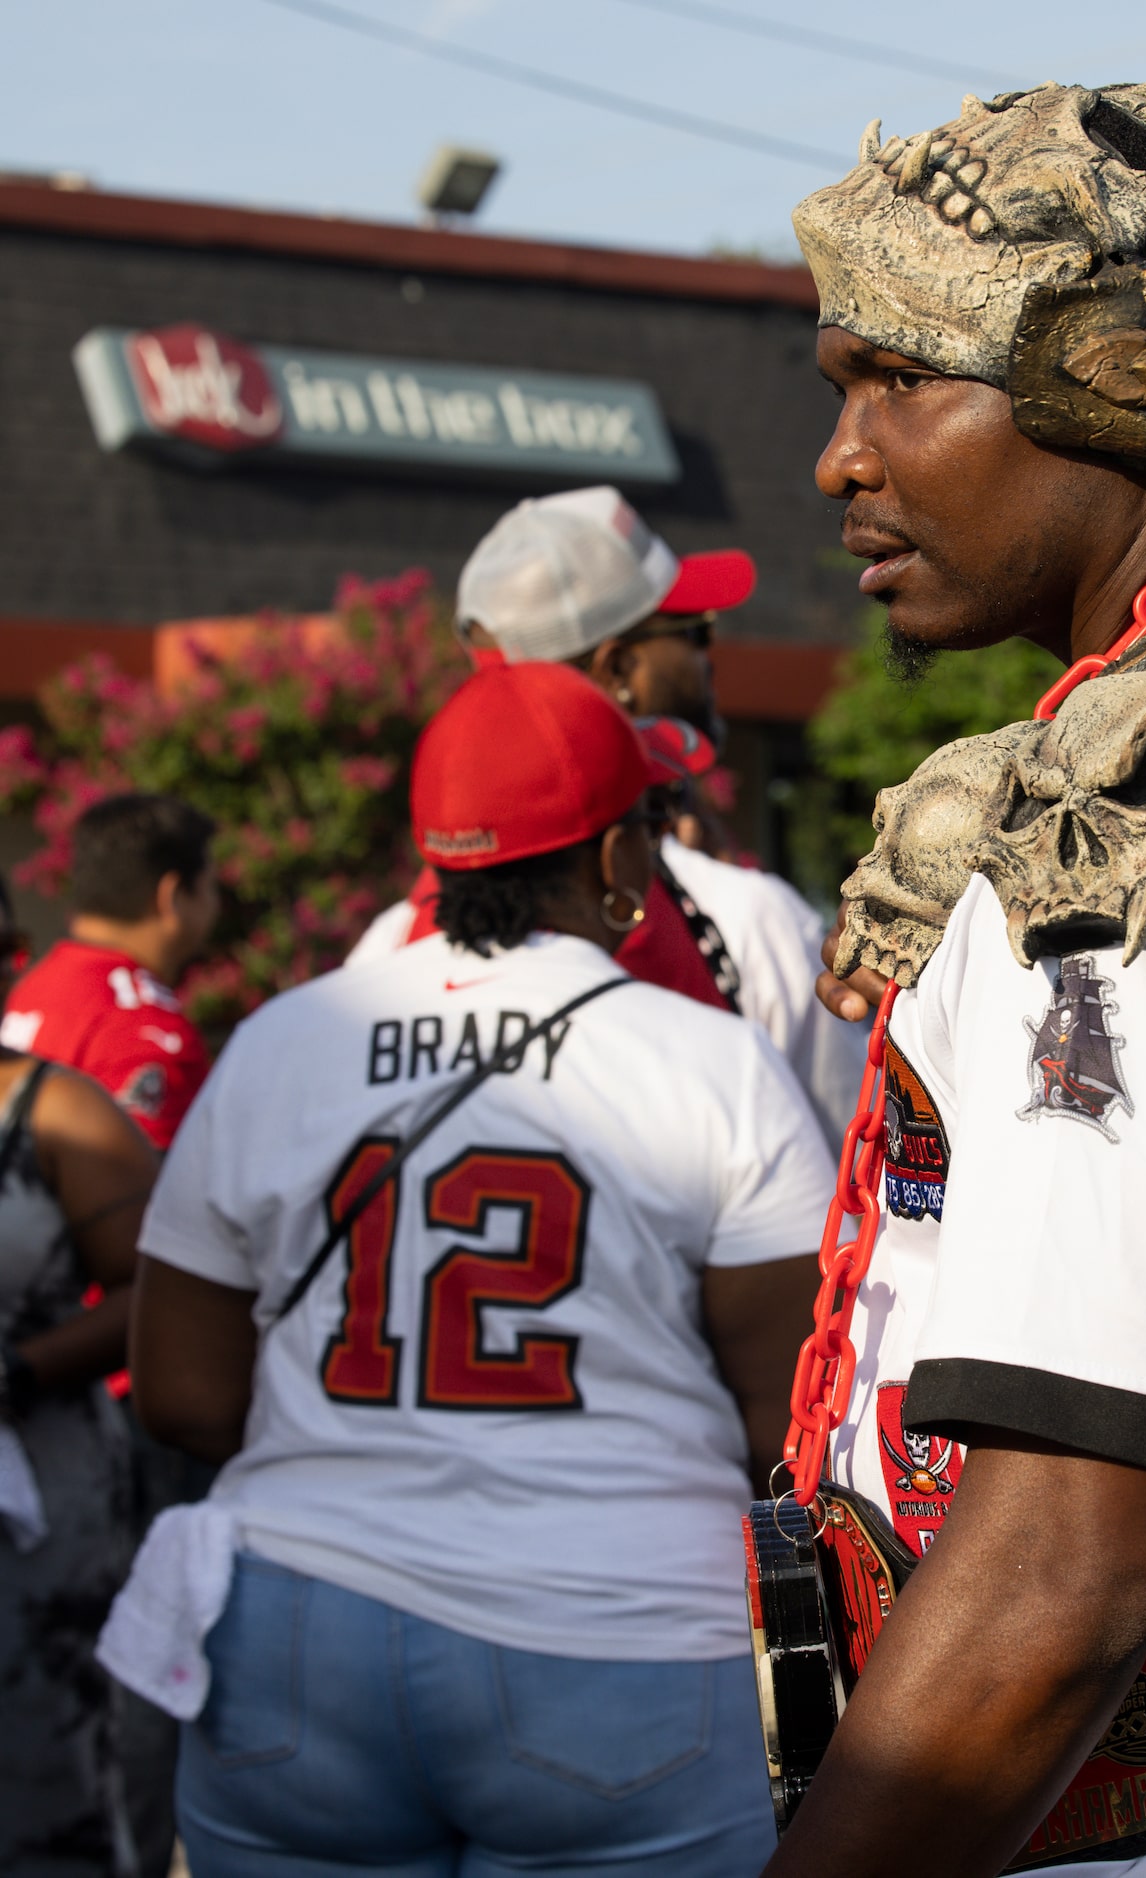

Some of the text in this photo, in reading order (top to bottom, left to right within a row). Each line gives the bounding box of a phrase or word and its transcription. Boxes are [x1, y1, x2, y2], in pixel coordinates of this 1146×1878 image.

[284, 361, 369, 434] in
[367, 370, 498, 444] the
[499, 382, 644, 457] box
[368, 1010, 572, 1086] BRADY
[903, 1134, 943, 1166] BUCS
[903, 1182, 921, 1207] 85
[321, 1136, 593, 1411] 12
[1118, 1696, 1146, 1714] UPER
